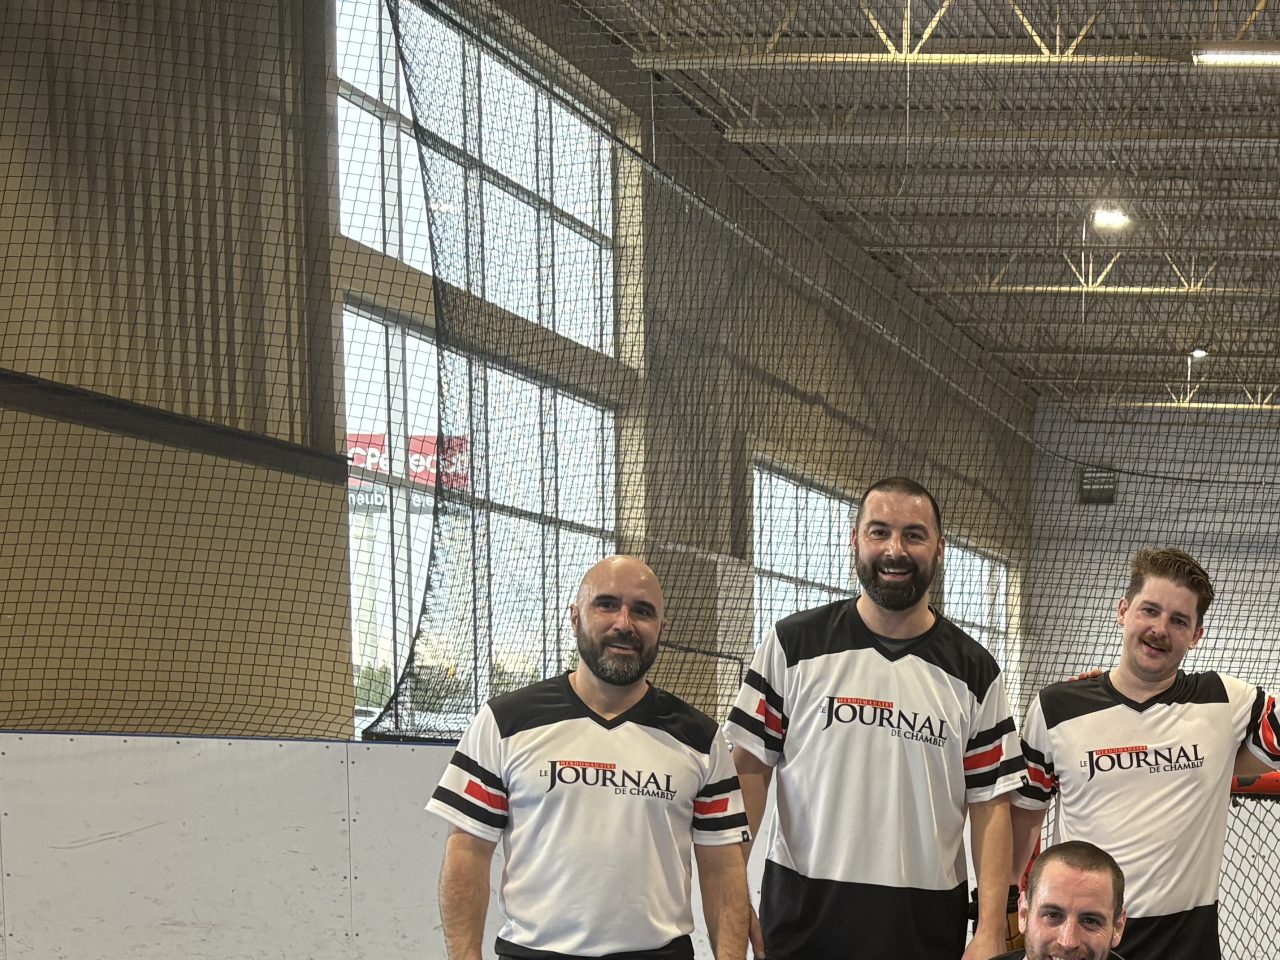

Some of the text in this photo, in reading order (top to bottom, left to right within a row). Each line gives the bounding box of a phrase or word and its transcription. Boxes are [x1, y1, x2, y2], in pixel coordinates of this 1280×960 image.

[822, 696, 947, 741] JOURNAL
[891, 729, 946, 748] DE CHAMBLY
[1086, 744, 1204, 782] JOURNAL
[1163, 761, 1204, 772] CHAMBLY
[545, 760, 677, 793] JOURNAL
[629, 788, 676, 801] CHAMBLY
